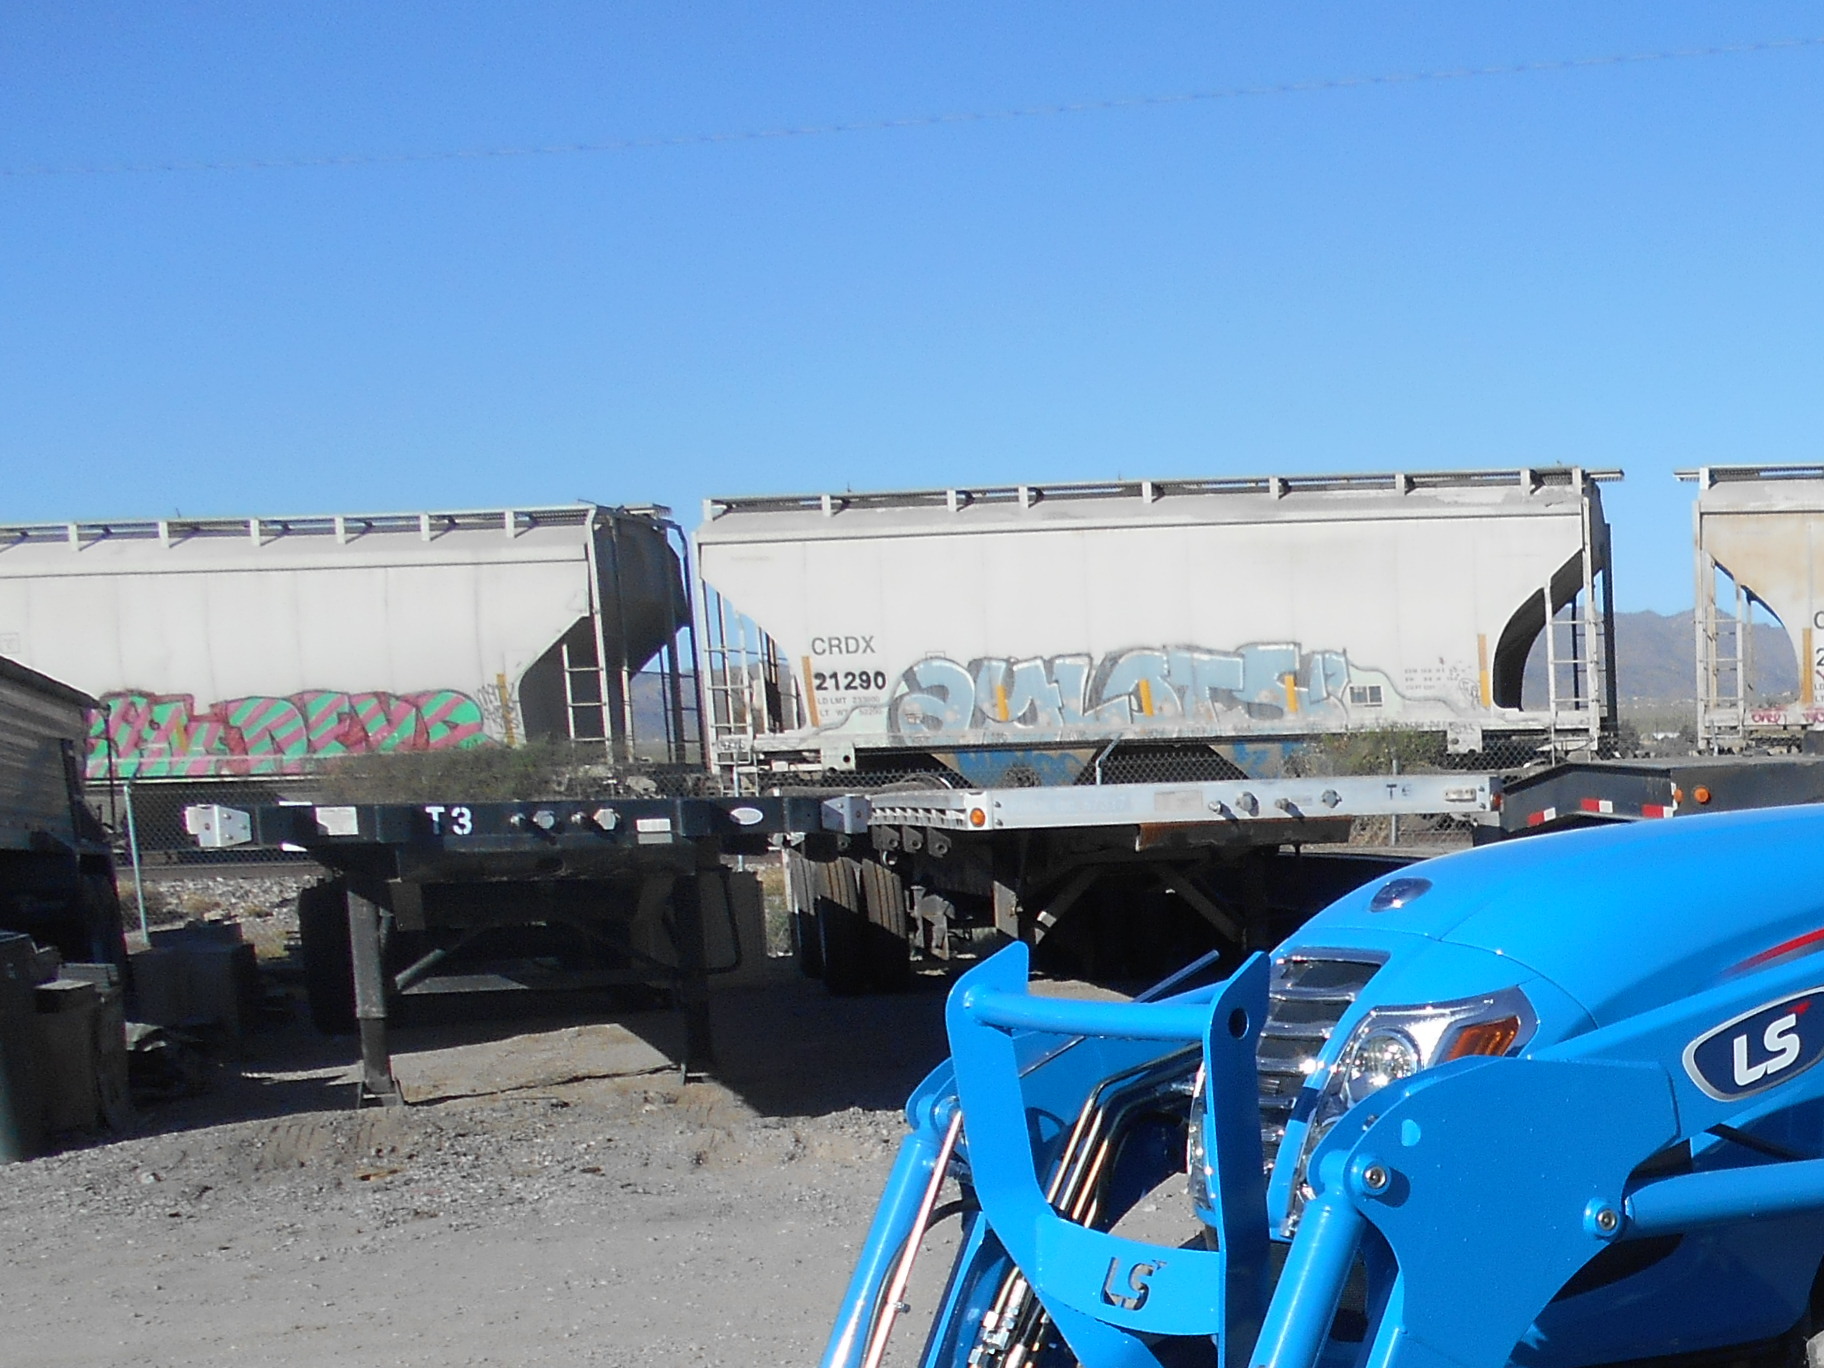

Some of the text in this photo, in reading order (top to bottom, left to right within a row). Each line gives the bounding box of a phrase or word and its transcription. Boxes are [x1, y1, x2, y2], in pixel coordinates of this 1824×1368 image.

[811, 635, 876, 656] CRDX
[813, 670, 887, 691] 21290
[1386, 783, 1398, 800] T
[425, 806, 473, 835] T 3
[1733, 1013, 1801, 1087] LS
[1100, 1256, 1155, 1311] LS
